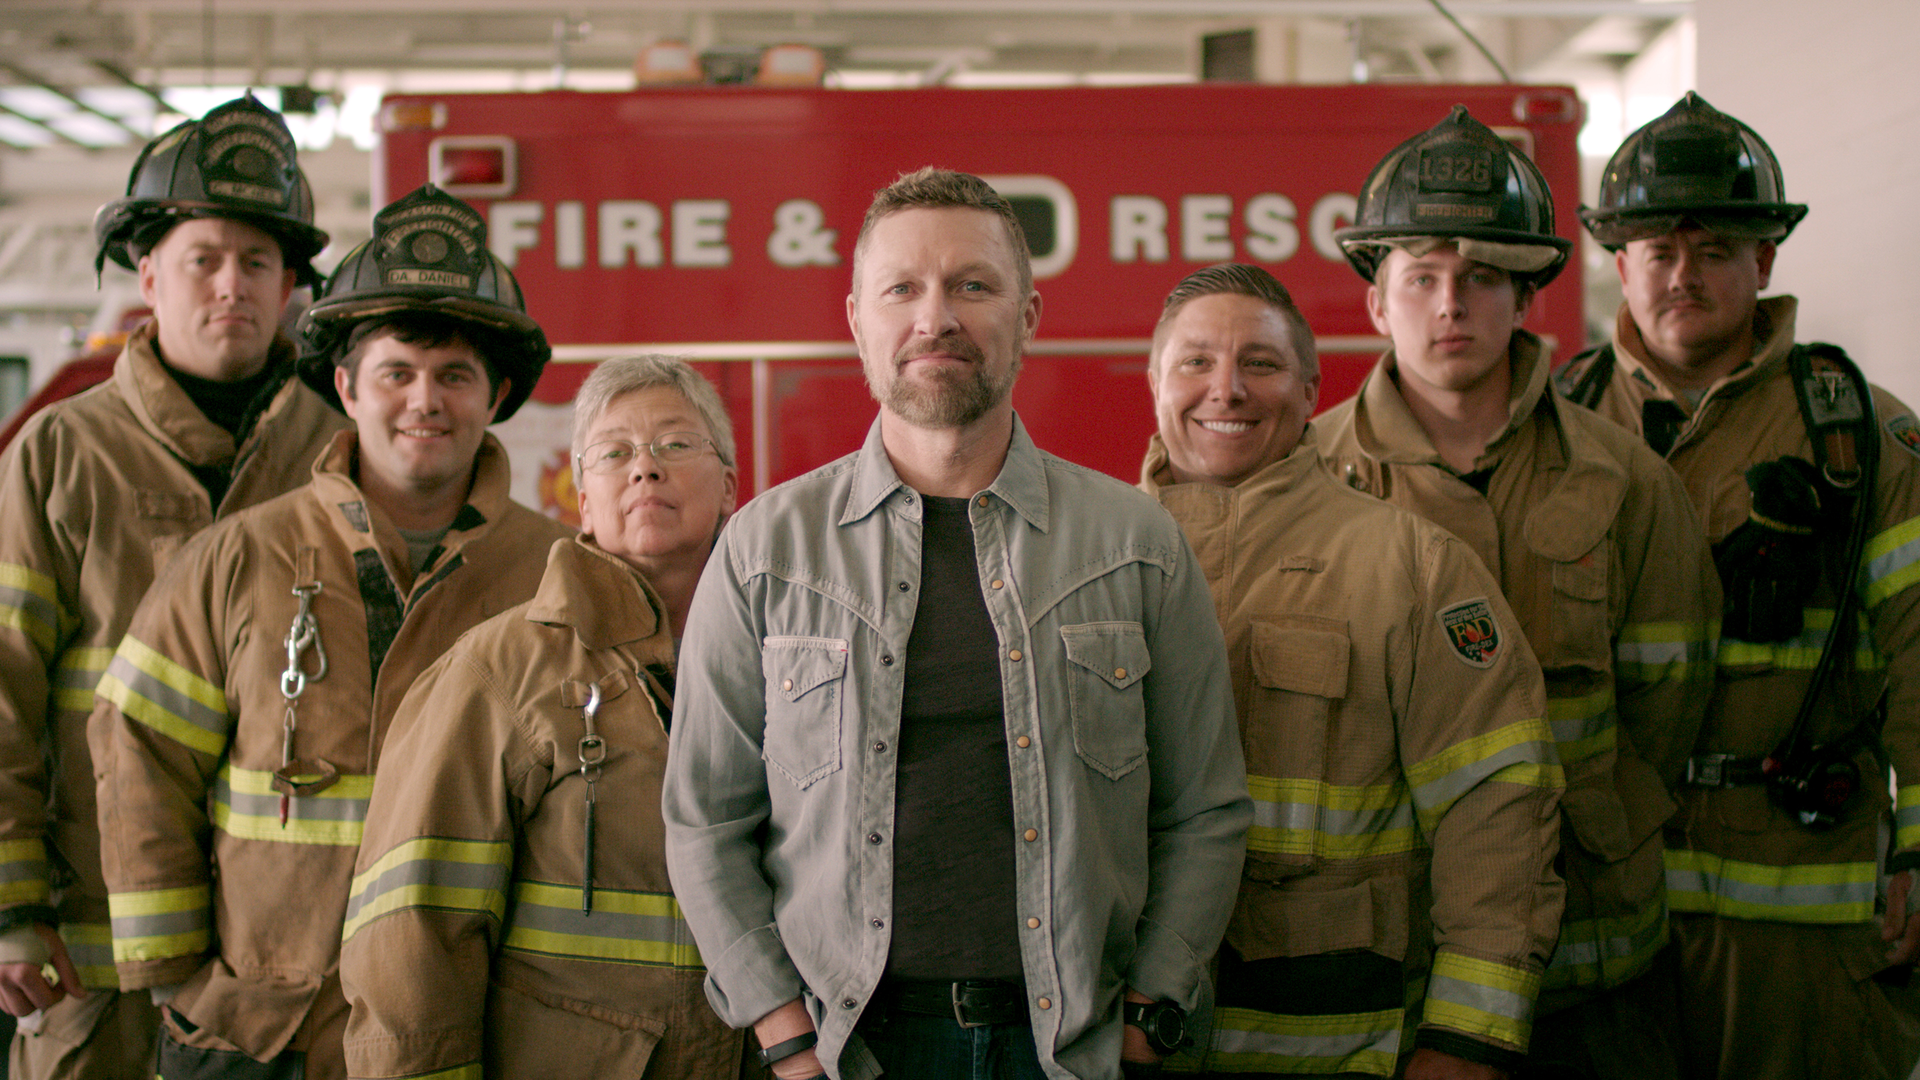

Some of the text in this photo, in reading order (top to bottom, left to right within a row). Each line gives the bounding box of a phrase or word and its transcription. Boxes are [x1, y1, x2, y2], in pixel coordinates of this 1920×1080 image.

[1420, 156, 1489, 183] 1326
[489, 200, 732, 268] FIRE
[766, 199, 842, 268] &
[418, 271, 466, 285] DANIEL
